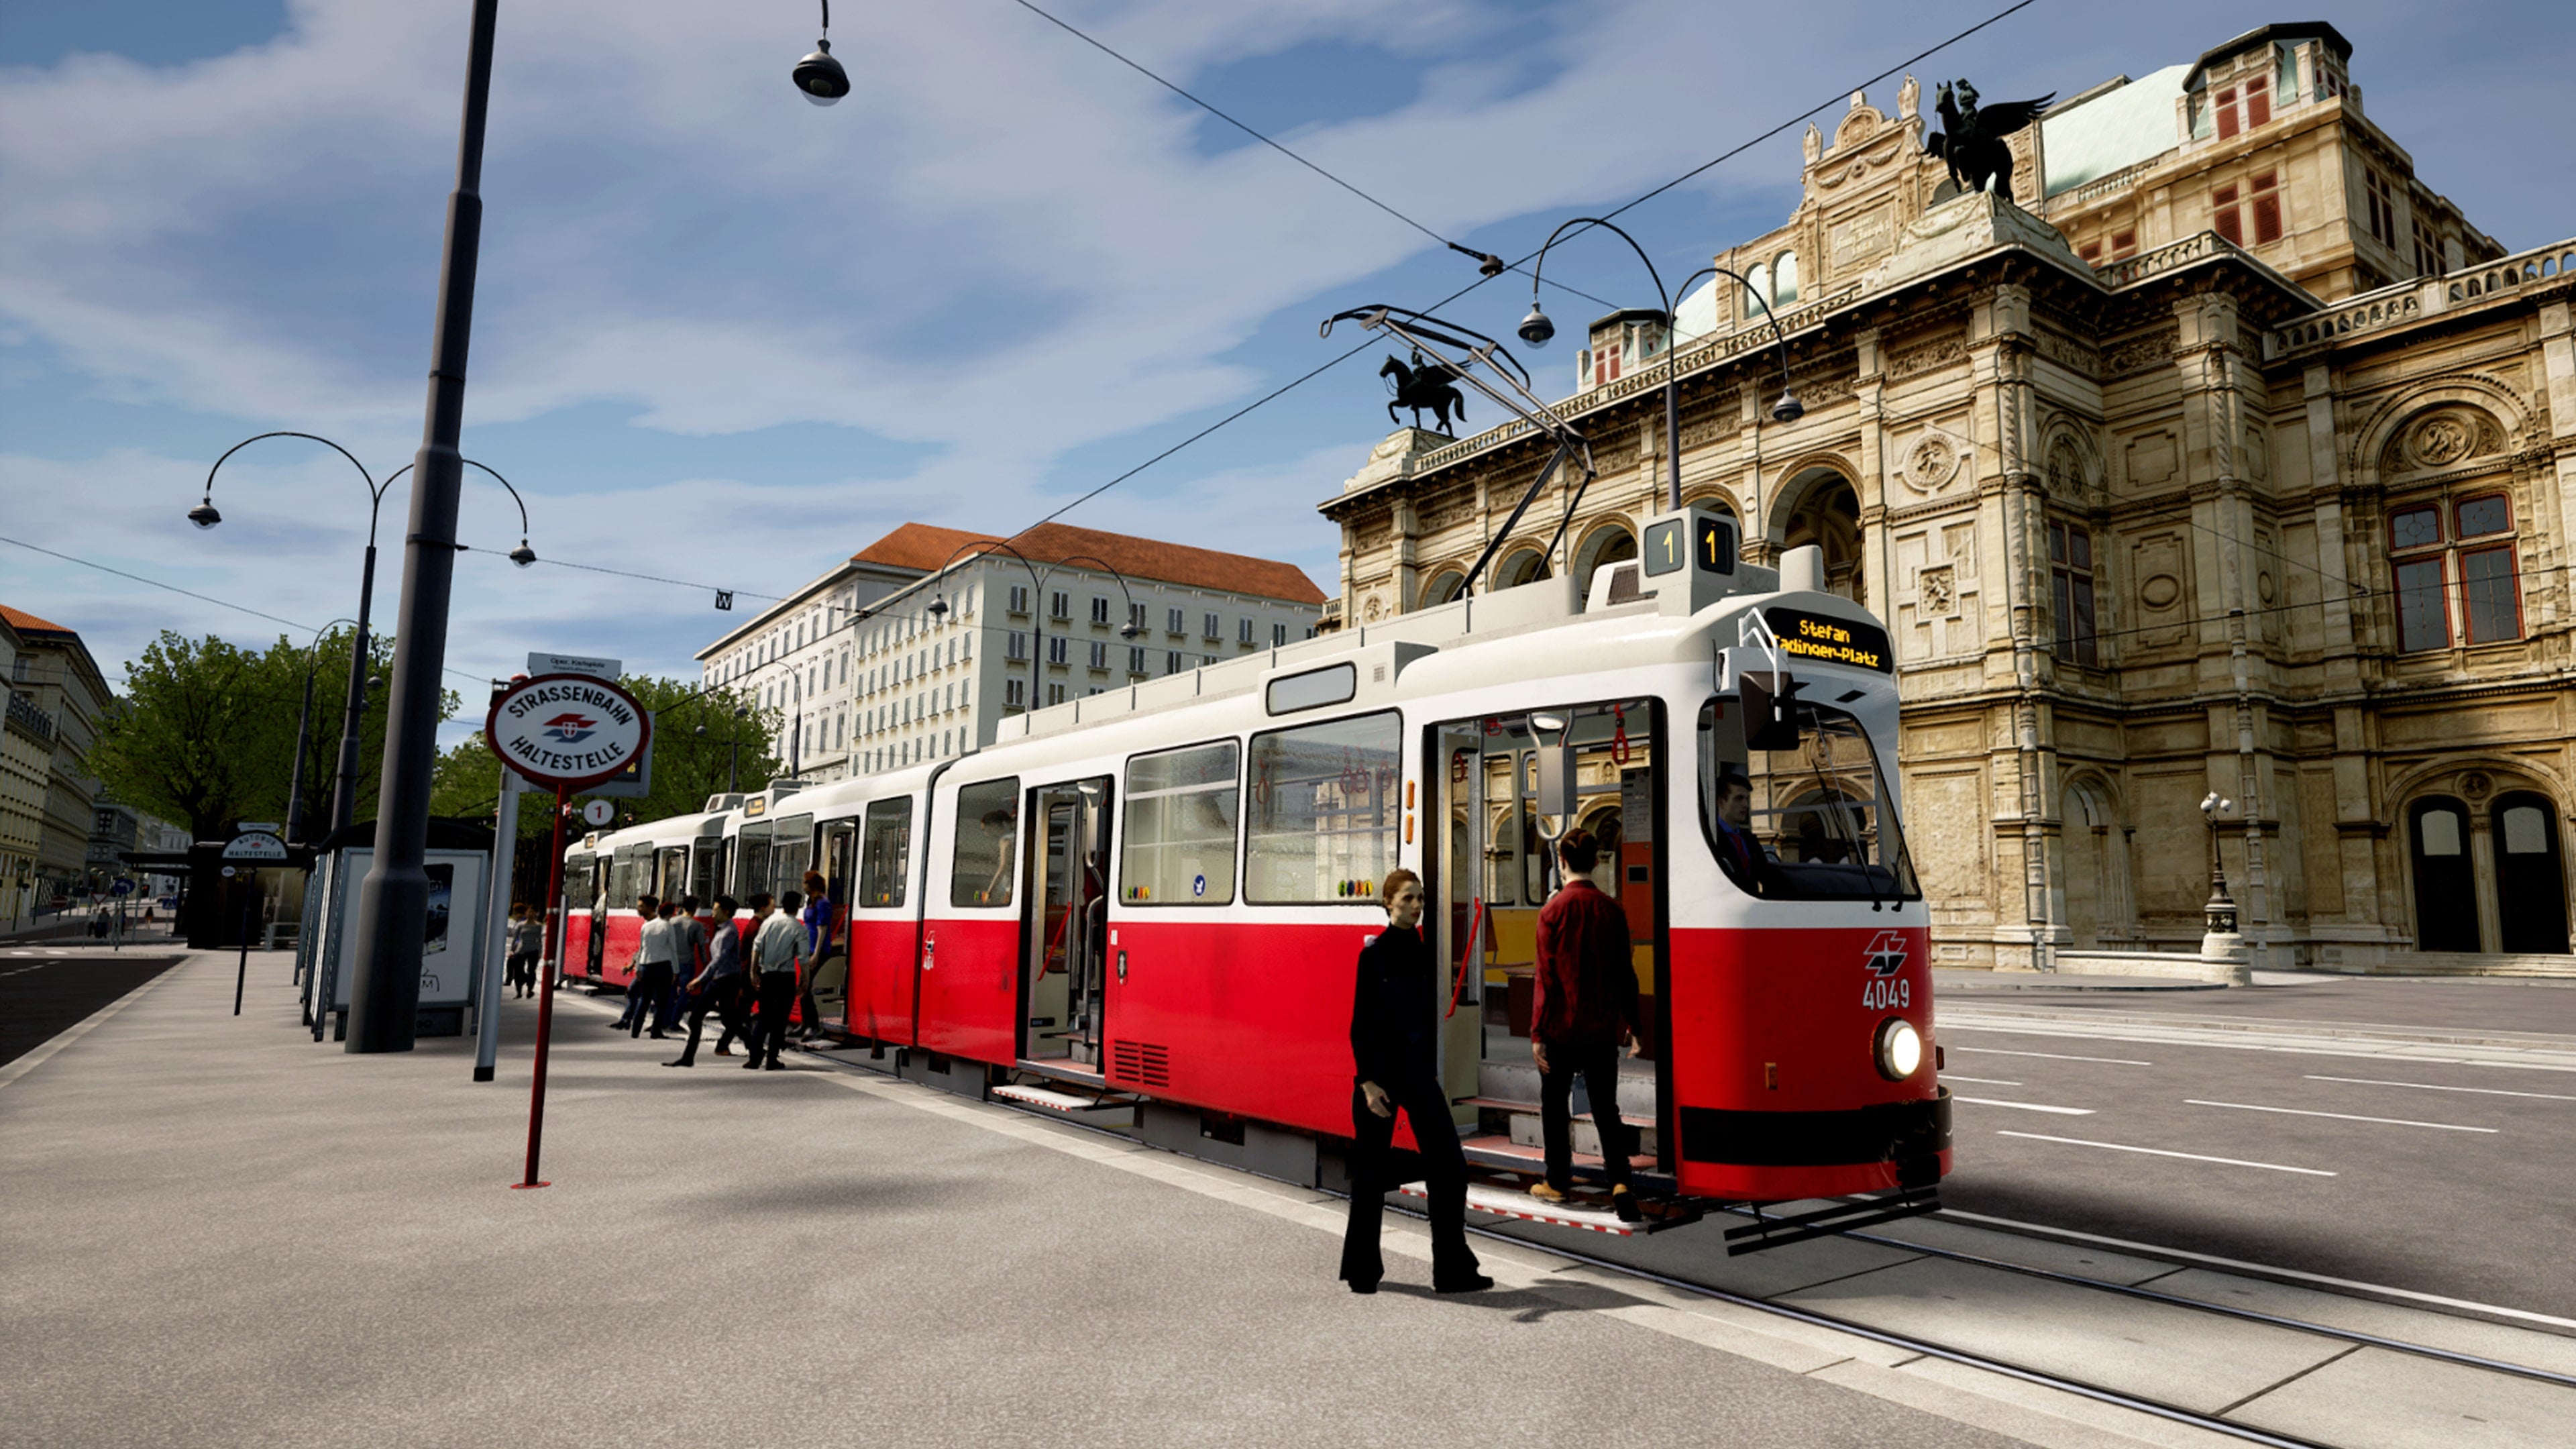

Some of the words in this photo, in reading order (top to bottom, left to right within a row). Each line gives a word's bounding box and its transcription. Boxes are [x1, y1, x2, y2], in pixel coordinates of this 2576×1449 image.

[1663, 530, 1674, 564] 1
[1706, 530, 1716, 564] 1
[718, 594, 731, 608] W
[1800, 619, 1850, 643] Stefan
[508, 686, 633, 727] STRASSENBAHN
[509, 735, 625, 770] HALTESTELLE
[594, 805, 602, 820] 1
[1863, 978, 1910, 1010] 4049
